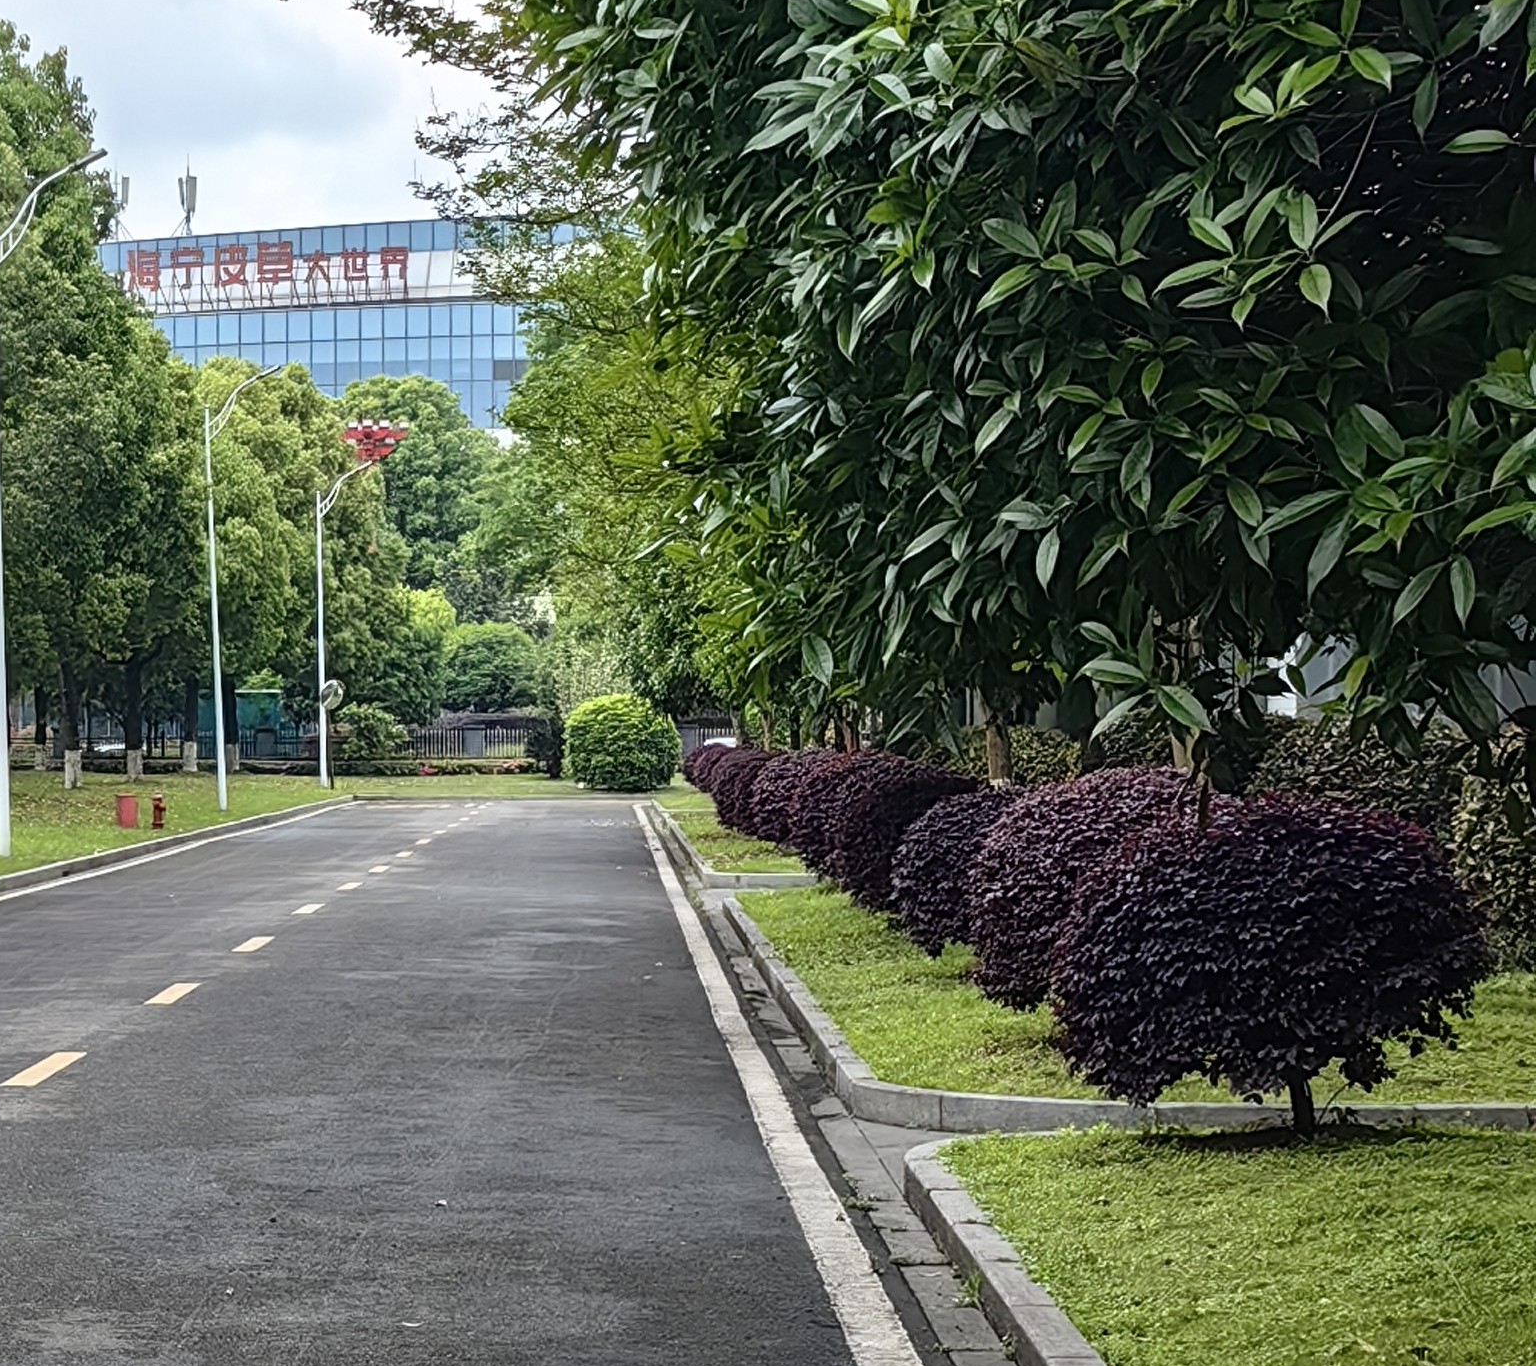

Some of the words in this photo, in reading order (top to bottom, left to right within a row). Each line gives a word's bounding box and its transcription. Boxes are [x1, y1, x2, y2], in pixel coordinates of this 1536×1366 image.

[127, 241, 409, 291] 海宁皮革大世界
